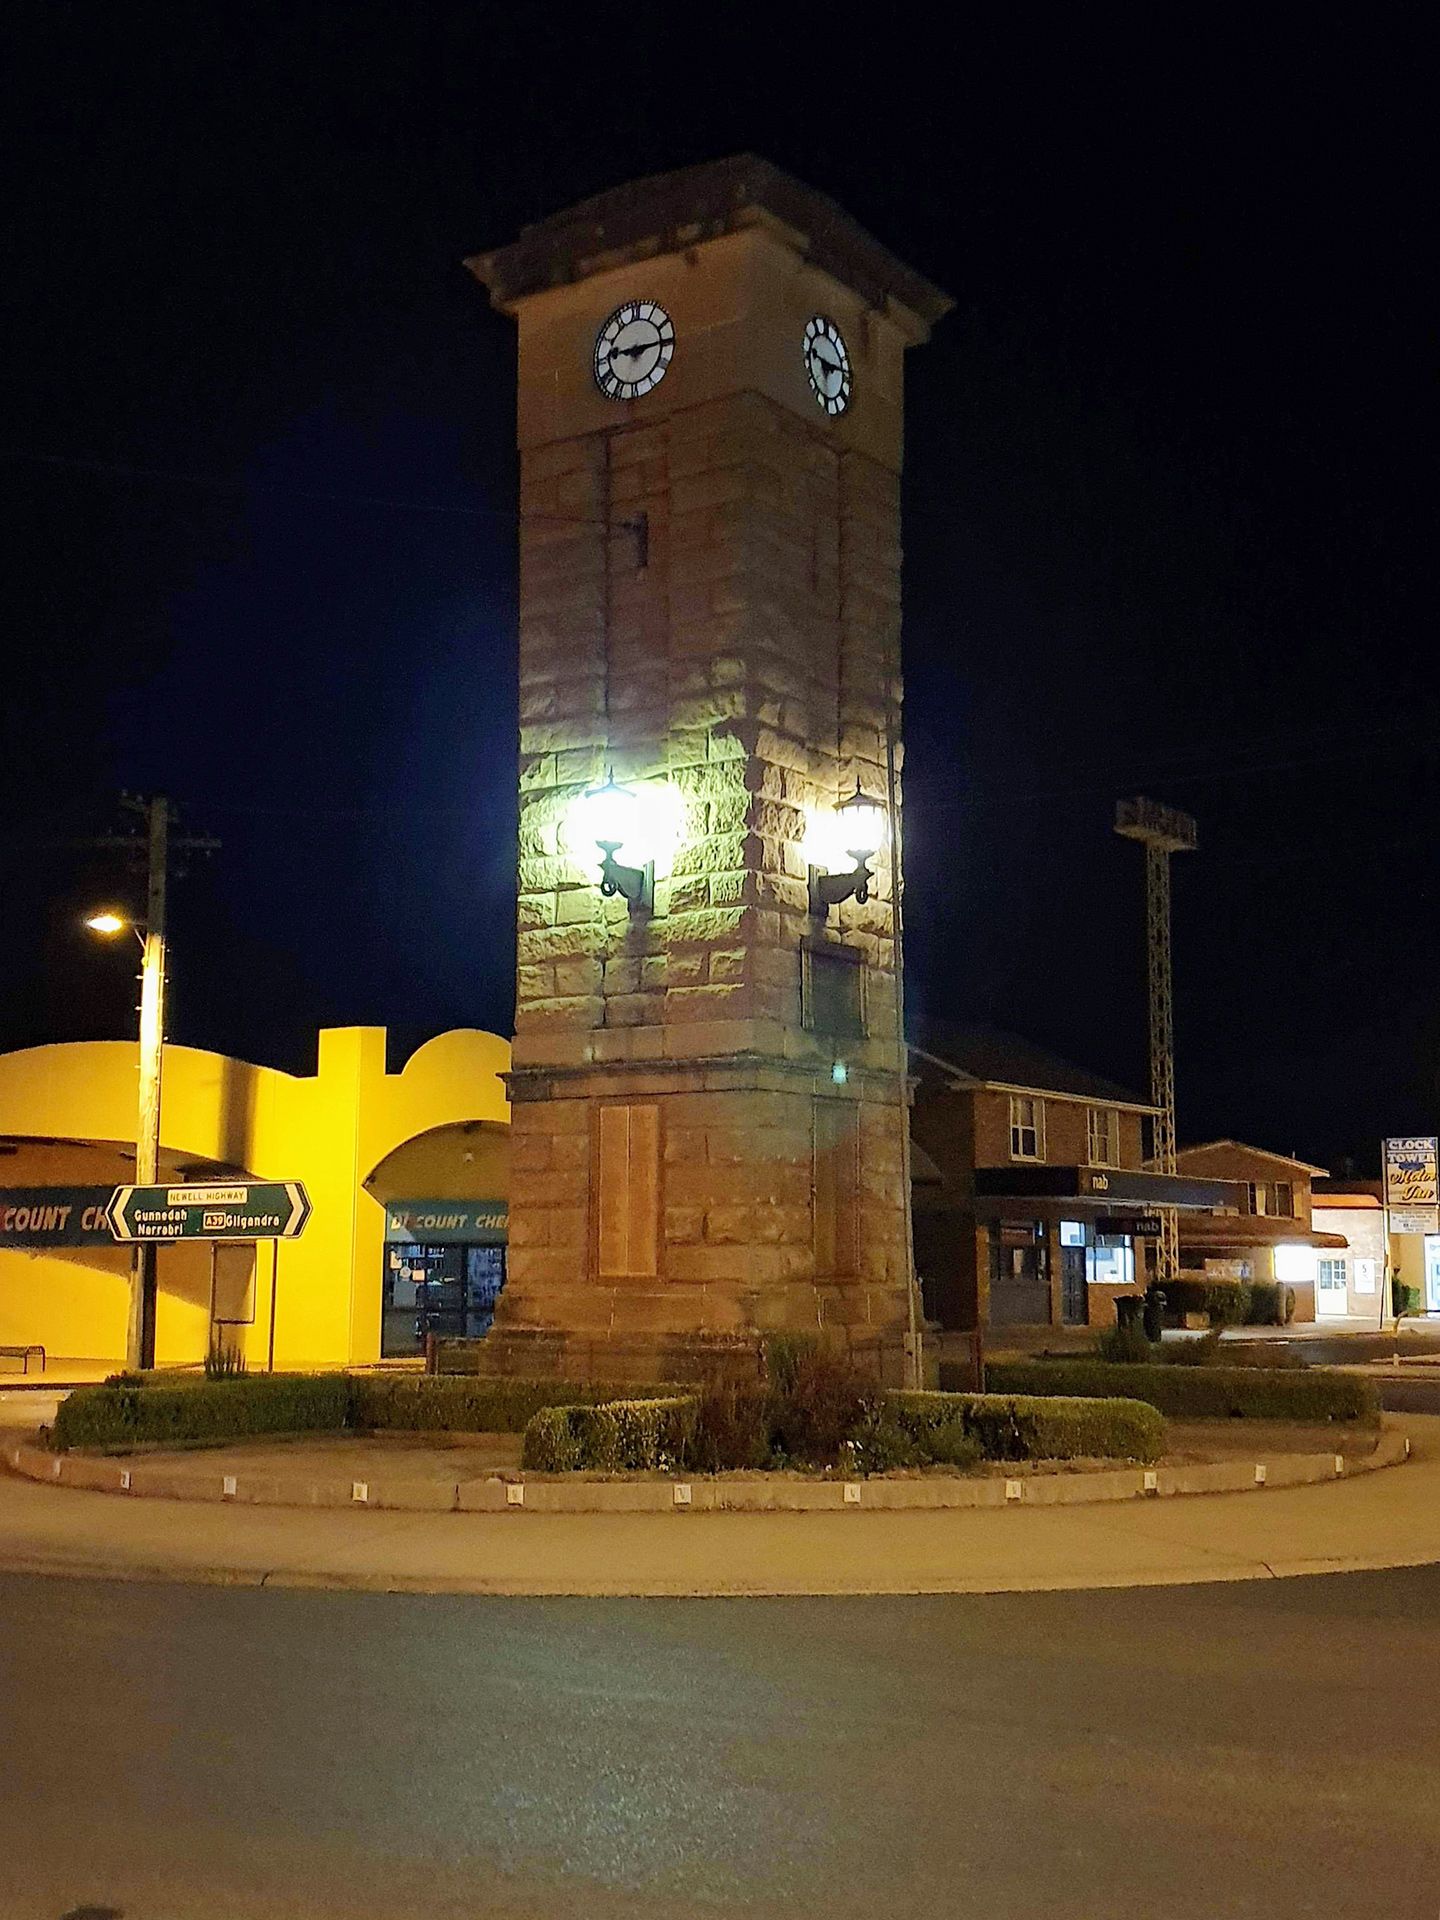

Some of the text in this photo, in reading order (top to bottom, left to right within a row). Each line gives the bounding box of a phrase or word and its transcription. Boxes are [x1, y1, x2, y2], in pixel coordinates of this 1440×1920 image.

[1388, 1140, 1435, 1150] CLOCK
[1387, 1153, 1436, 1163] TOWER
[1092, 1174, 1109, 1190] nab
[170, 1191, 245, 1202] NEWELL HIGHWAY
[1402, 1185, 1434, 1201] Inn
[0, 1206, 72, 1232] COUNT
[134, 1209, 188, 1222] Gunnedah
[206, 1215, 224, 1226] A39
[226, 1214, 280, 1230] Gilgandra
[137, 1223, 183, 1236] Narrabri
[1136, 1220, 1159, 1232] nab
